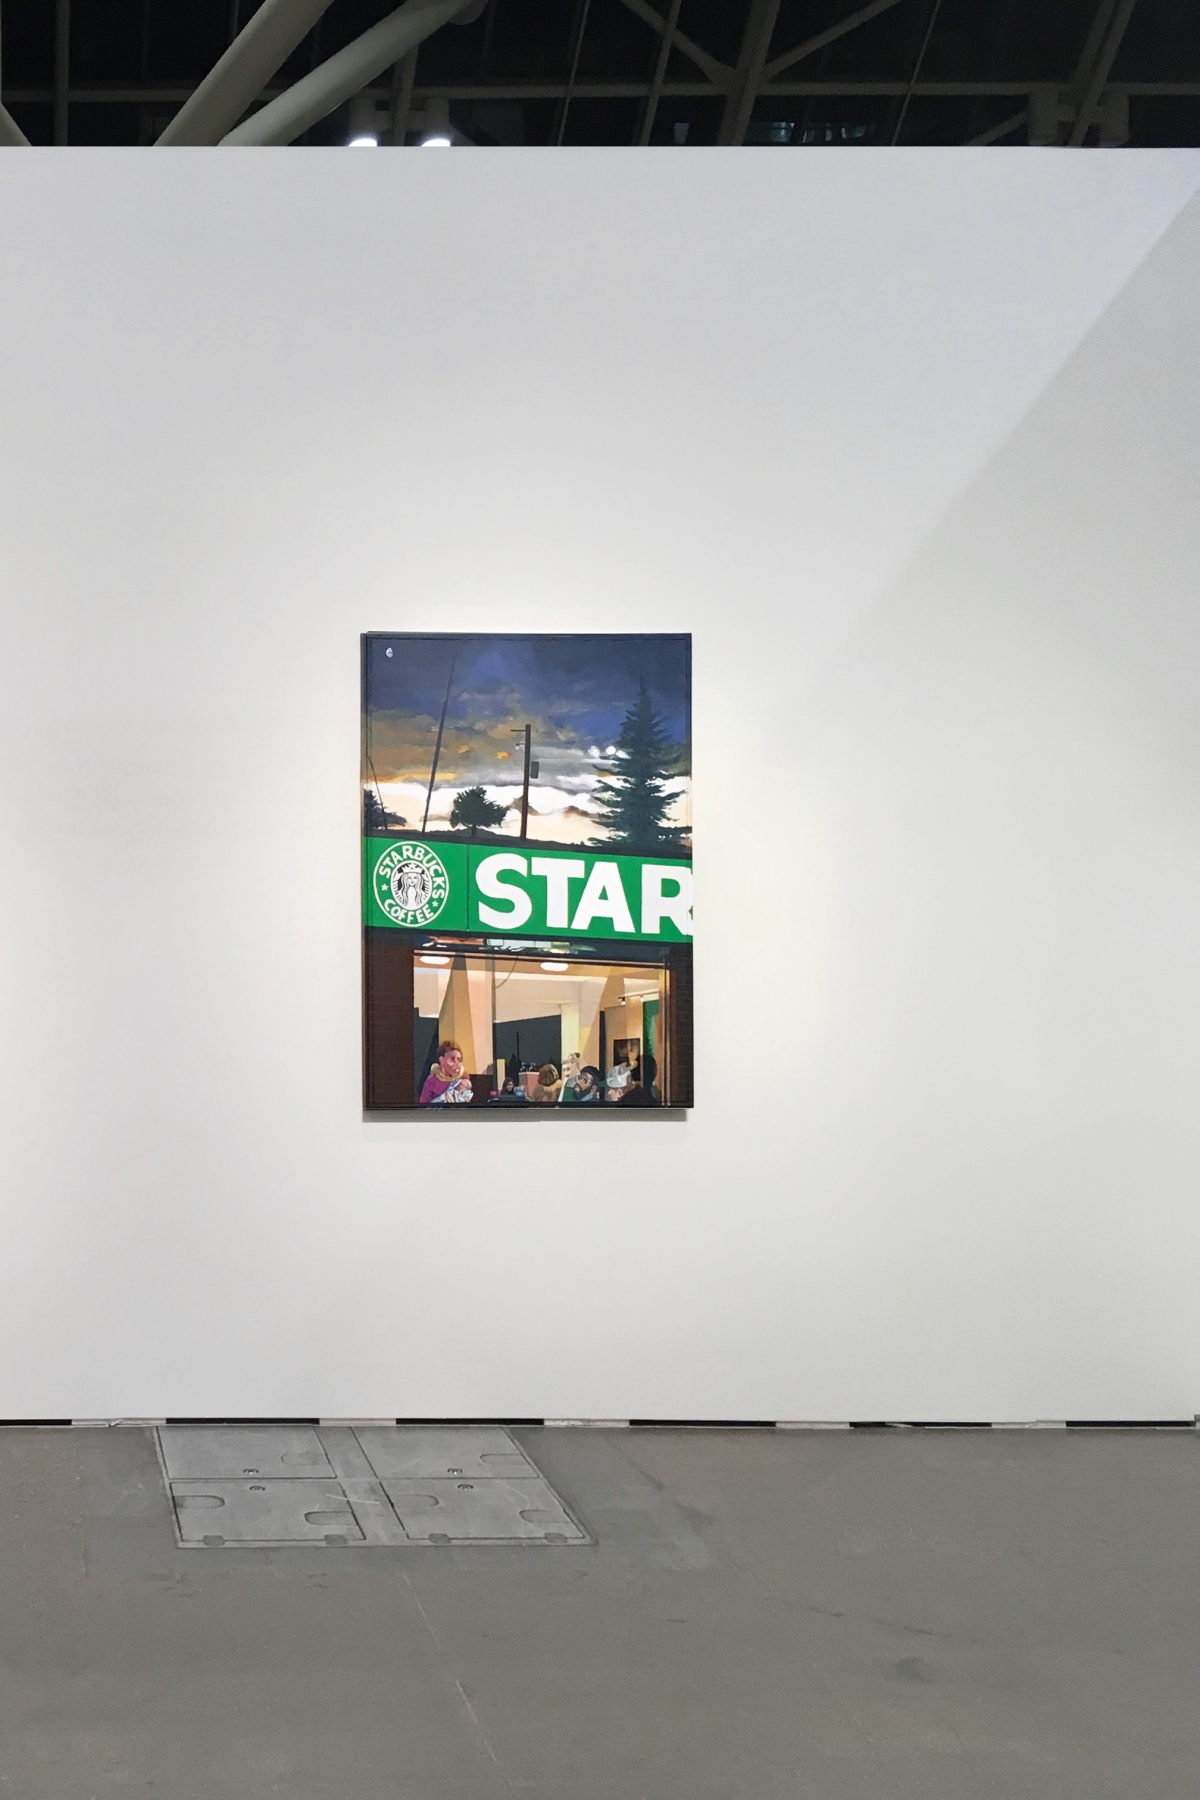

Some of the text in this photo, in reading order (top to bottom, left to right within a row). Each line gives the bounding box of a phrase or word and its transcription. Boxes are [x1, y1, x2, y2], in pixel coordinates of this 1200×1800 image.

[379, 845, 445, 899] STARBUCKS
[475, 852, 693, 936] STAR
[384, 899, 434, 923] COFFEE
